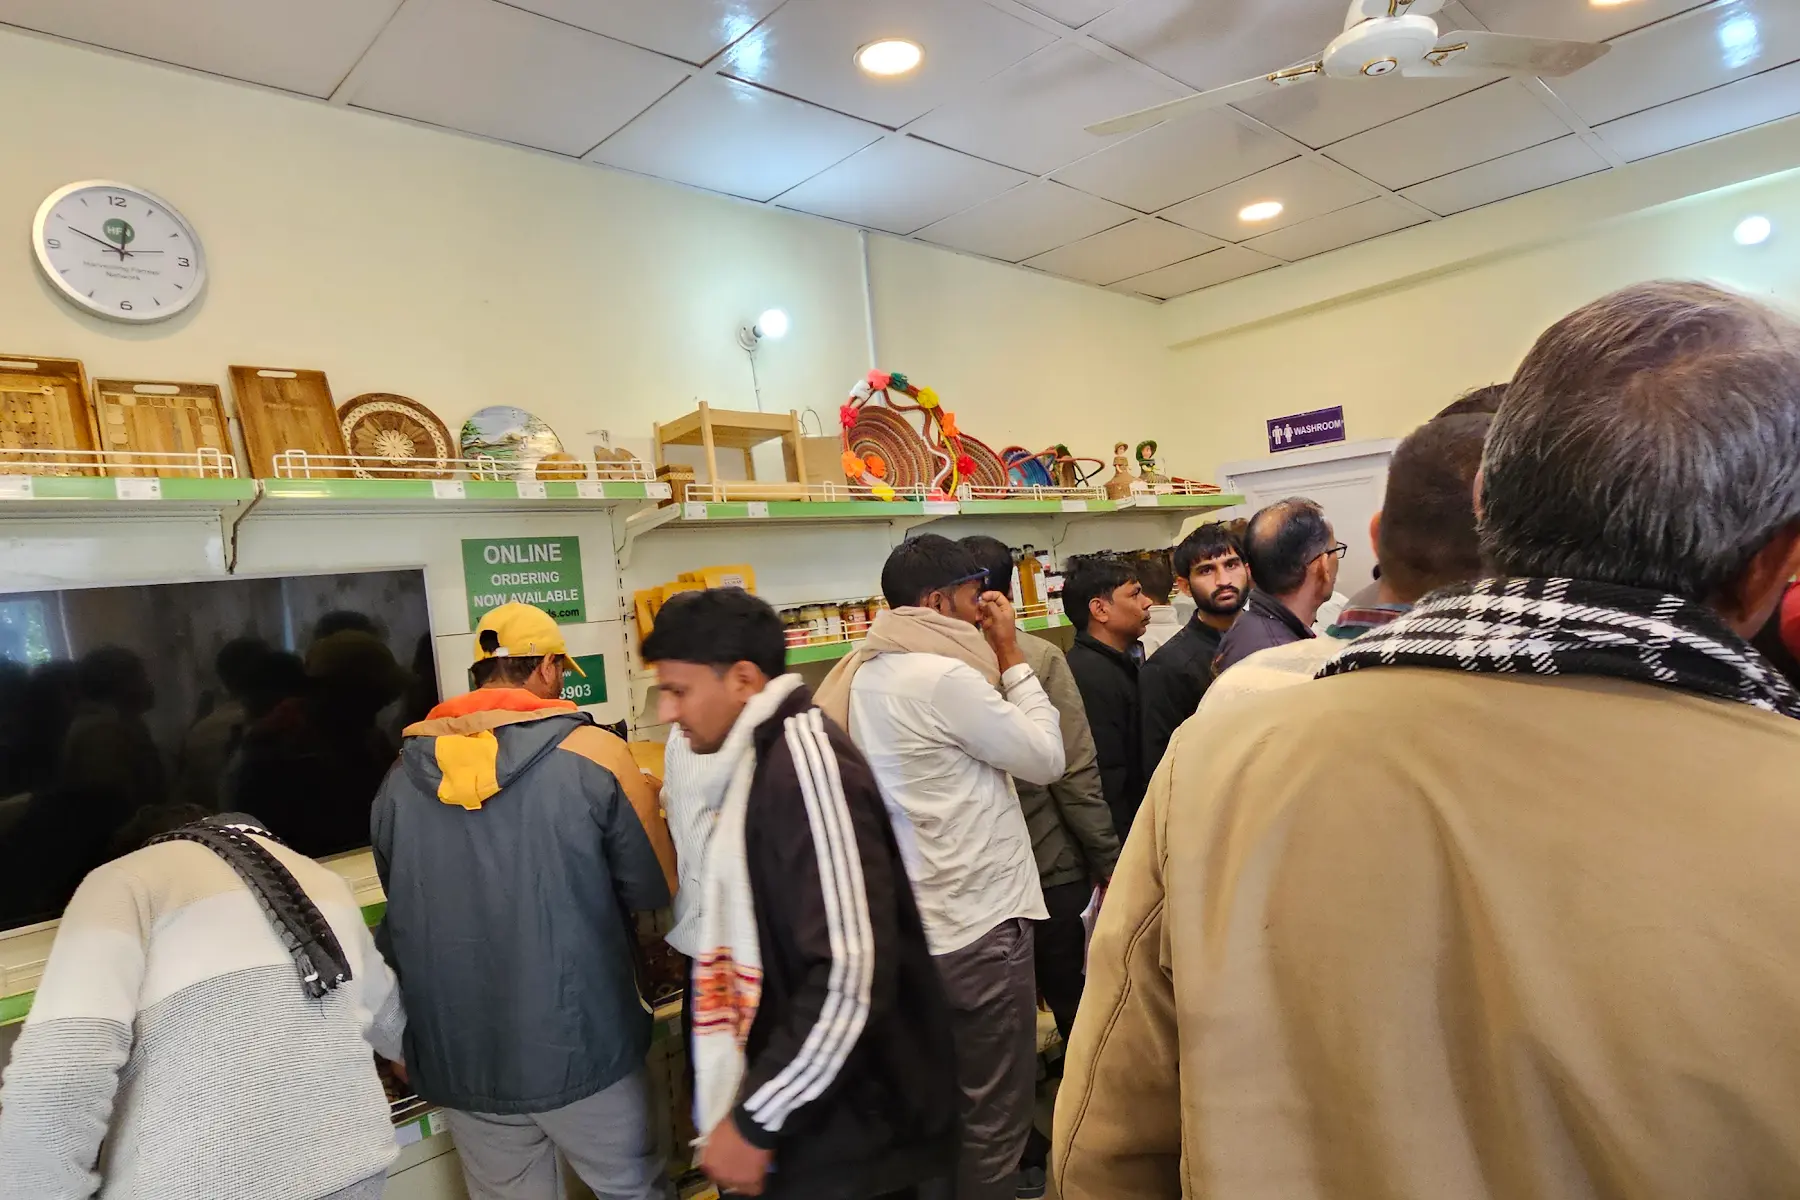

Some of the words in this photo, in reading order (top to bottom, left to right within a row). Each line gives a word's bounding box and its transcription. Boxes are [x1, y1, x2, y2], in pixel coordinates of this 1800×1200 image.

[107, 195, 127, 208] 12
[47, 238, 61, 249] 9
[178, 257, 190, 267] 3
[120, 300, 133, 311] 6
[1293, 419, 1341, 436] WASHROOM
[483, 543, 562, 564] ONLINE
[491, 571, 560, 586] ORDERING
[473, 593, 507, 607] NOW
[511, 589, 579, 604] AVAILABLE
